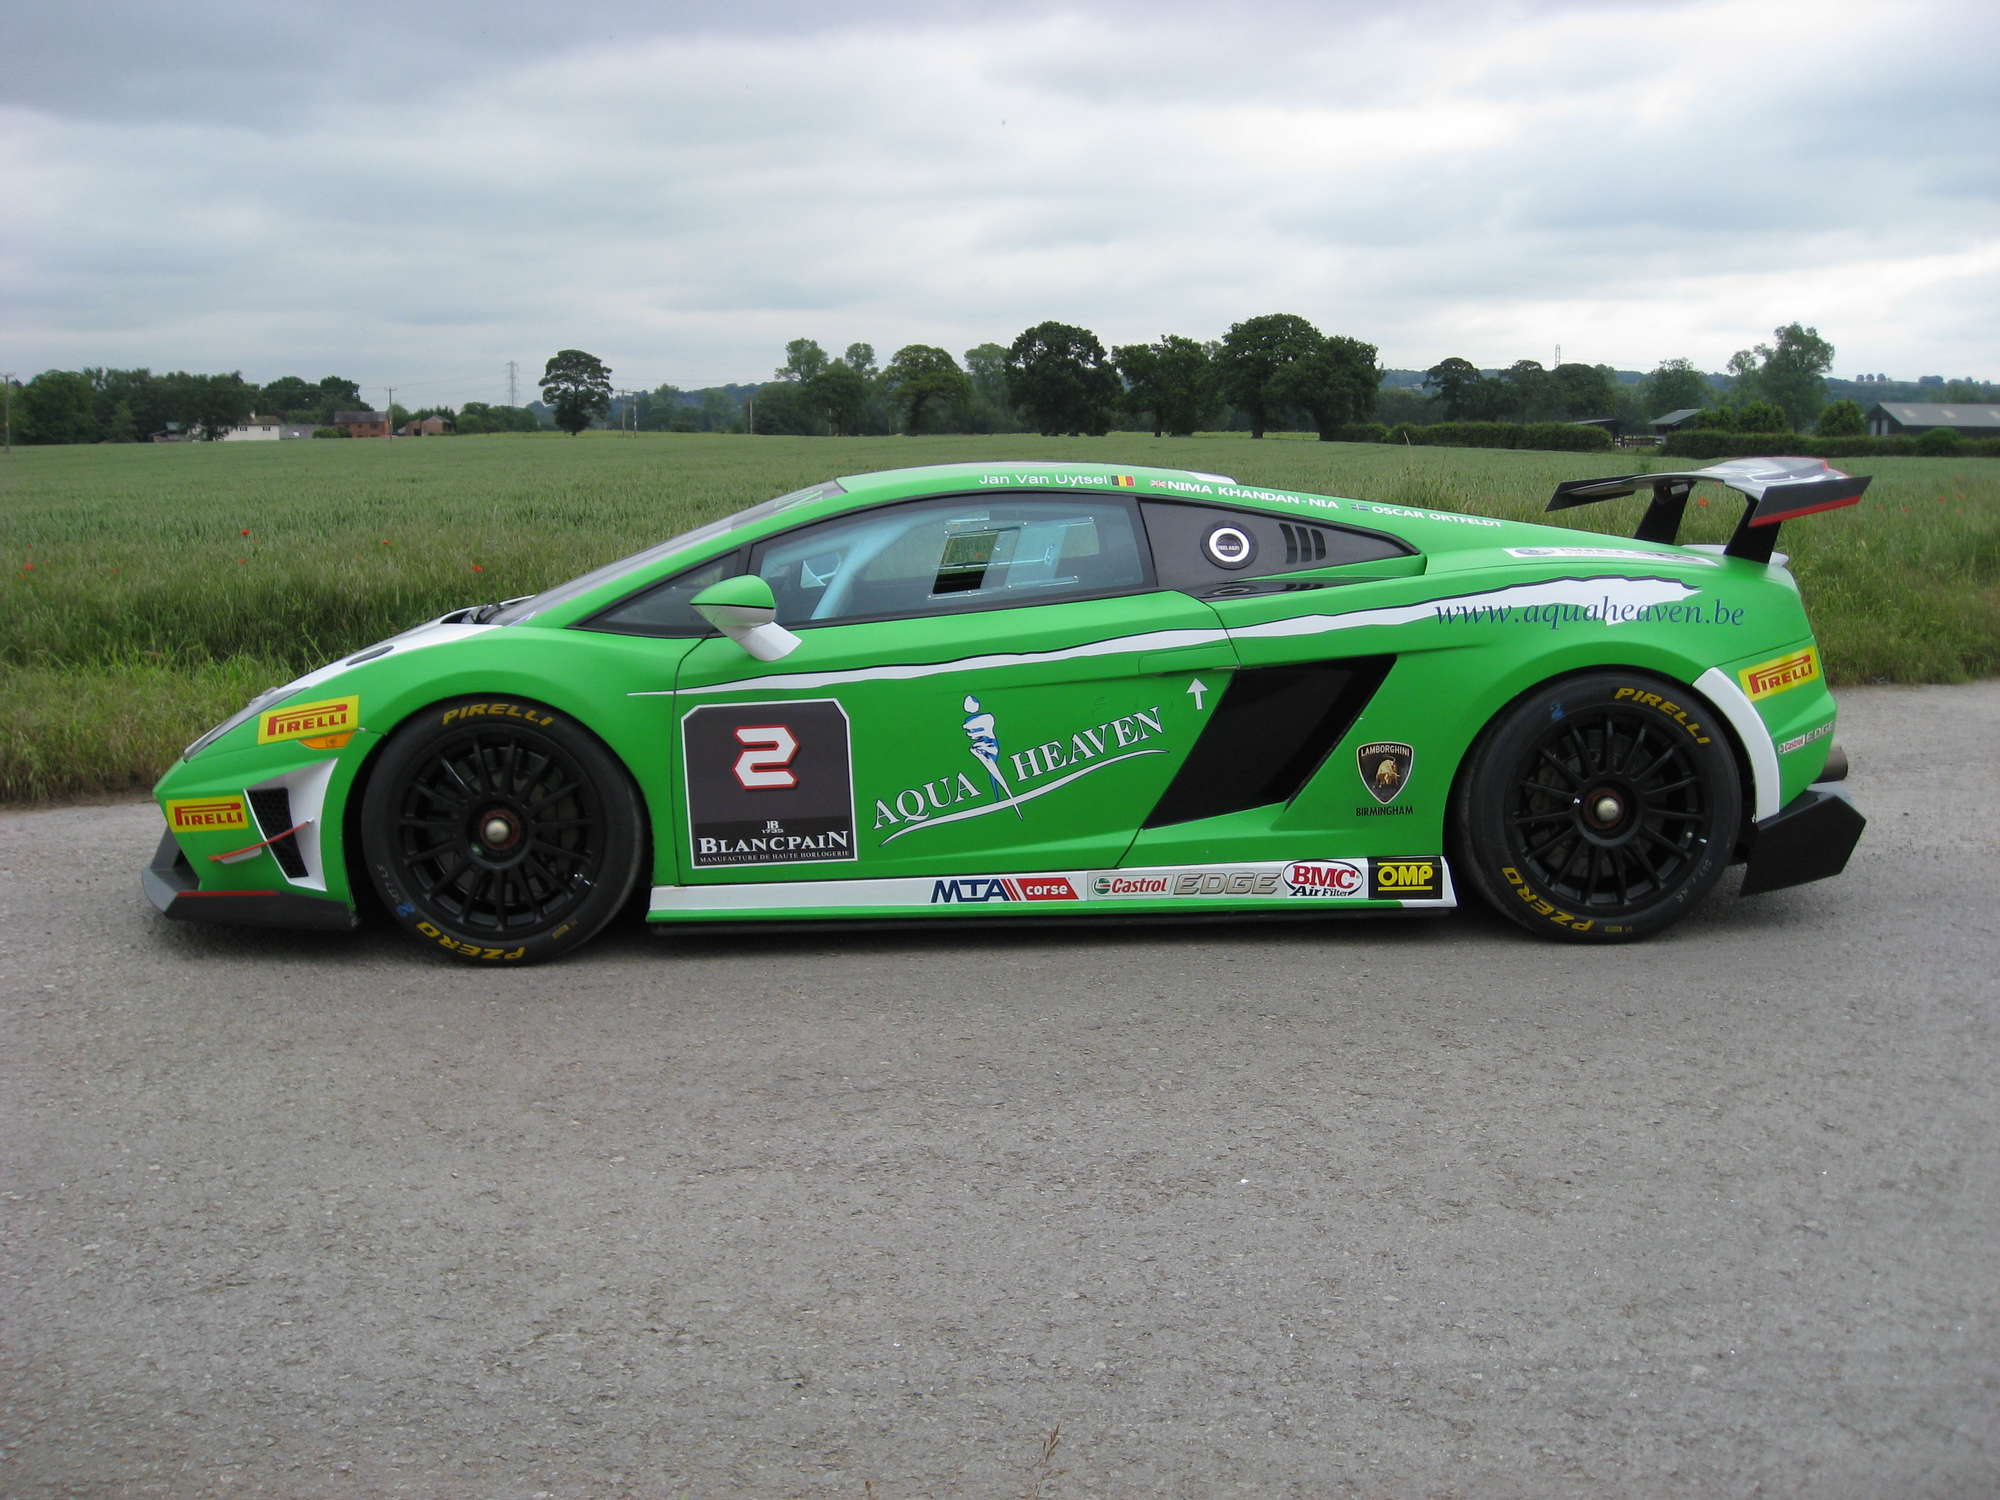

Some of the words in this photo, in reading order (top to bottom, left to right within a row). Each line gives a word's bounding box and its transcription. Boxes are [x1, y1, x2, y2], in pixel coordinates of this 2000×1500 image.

[979, 474, 1010, 484] Jan
[1015, 474, 1049, 484] Van
[1055, 474, 1108, 486] Uytsel
[1168, 481, 1212, 494] NIMA
[1371, 506, 1425, 519] OSCAR
[1435, 596, 1745, 630] www.aquaheaven.be
[1748, 655, 1813, 694] PIRELLI
[267, 703, 348, 736] PIRELLI
[441, 703, 555, 727] PIRELLI
[1615, 687, 1712, 744] PIRELLI
[732, 724, 800, 790] 2
[1360, 744, 1410, 757] LAMBORGHINI
[873, 772, 982, 830] AQUA
[1008, 706, 1165, 782] HEAVEN
[174, 803, 244, 826] PIRELLI
[1355, 805, 1414, 817] BIRMINGHAM
[700, 854, 757, 863] MANUFACTURE
[772, 852, 798, 860] HAUTE
[1111, 877, 1168, 894] Castrol
[1174, 872, 1282, 896] EDGE
[1291, 865, 1356, 888] BMC
[1377, 865, 1433, 886] OMP
[931, 879, 1011, 903] MTA
[1025, 884, 1068, 896] corse
[1289, 886, 1321, 896] Air
